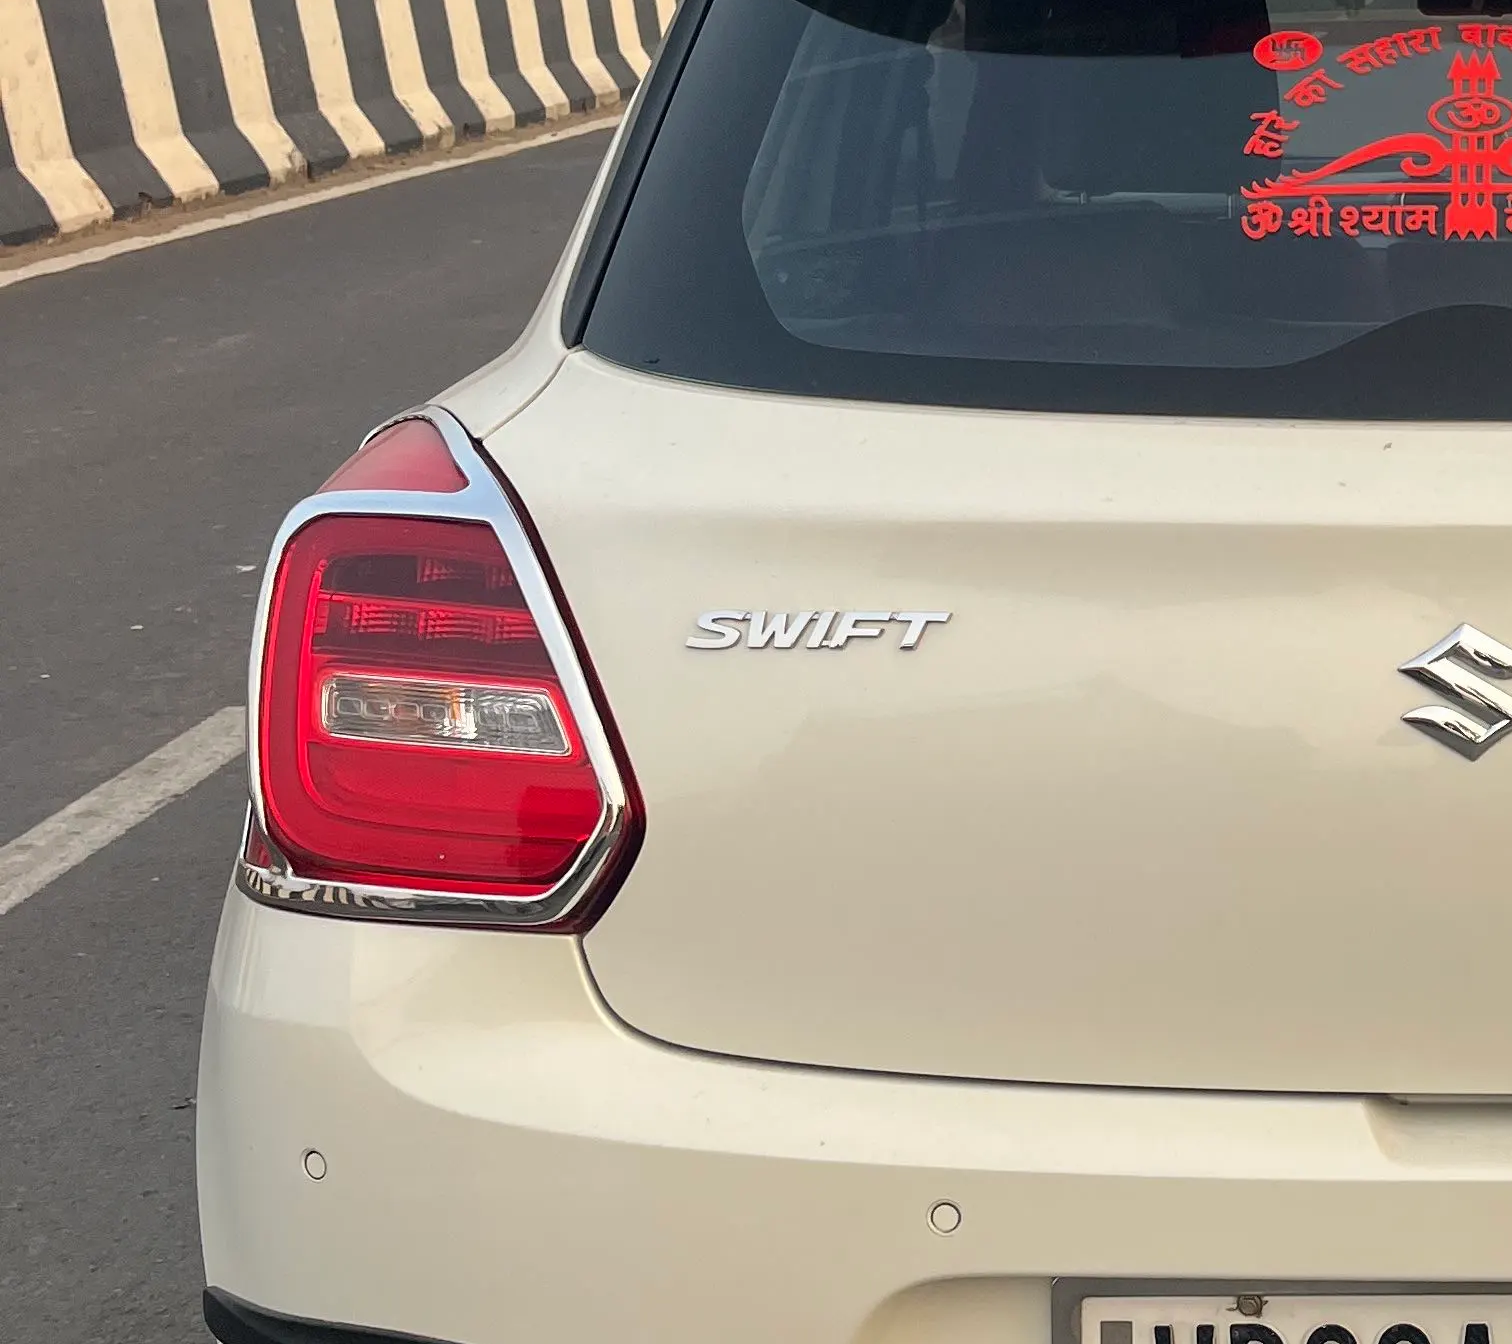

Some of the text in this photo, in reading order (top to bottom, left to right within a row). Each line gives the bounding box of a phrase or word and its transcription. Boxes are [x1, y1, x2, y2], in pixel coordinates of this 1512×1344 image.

[1284, 68, 1345, 107] का
[1337, 26, 1443, 75] सहारा
[1288, 195, 1334, 237] श्री
[1339, 205, 1440, 237] श्याम
[685, 609, 952, 650] SWIFT
